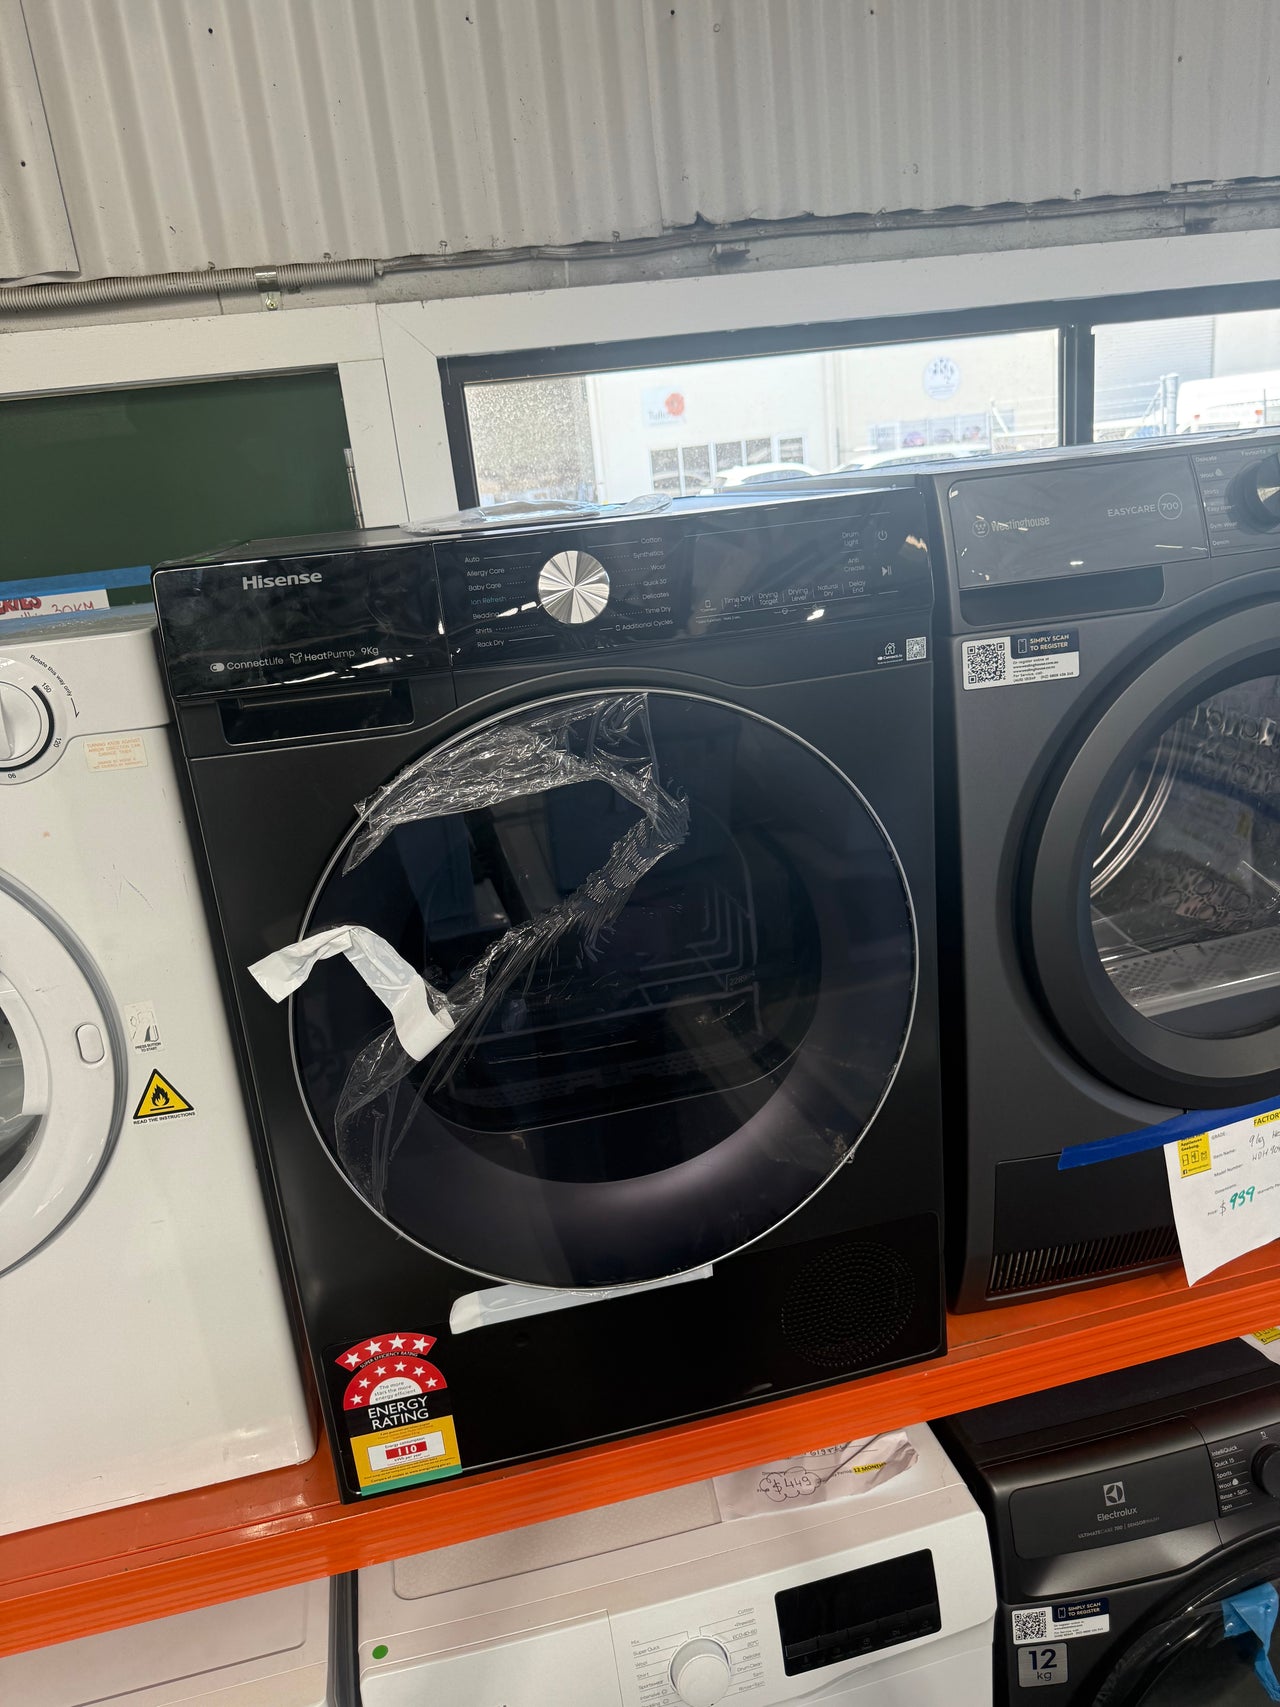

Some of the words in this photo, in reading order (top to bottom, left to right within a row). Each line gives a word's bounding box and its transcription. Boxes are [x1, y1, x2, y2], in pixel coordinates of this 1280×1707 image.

[1107, 504, 1156, 517] EASYCARE
[1161, 502, 1179, 511] 700
[633, 550, 664, 559] Synthetics
[242, 570, 323, 591] Hisense
[482, 596, 507, 604] Refresh
[643, 592, 670, 600] Delicates
[758, 592, 778, 601] Drying
[473, 612, 500, 620] Bedding
[622, 621, 652, 630] Additional
[653, 619, 674, 627] Cycles
[475, 627, 493, 635] Shirts
[1030, 636, 1051, 644] SIMPLY
[1052, 634, 1070, 642] SCAN
[1040, 642, 1068, 650] REGISTER
[227, 657, 284, 670] ConnectLife
[304, 650, 355, 662] HeatPump
[361, 647, 379, 656] 9Kg
[30, 654, 48, 669] Rotate
[48, 664, 57, 676] this
[56, 674, 65, 686] way
[64, 685, 73, 697] only
[41, 682, 52, 694] 150
[53, 737, 62, 748] 120
[159, 1112, 196, 1120] INSTRUCTIONS
[1253, 1112, 1280, 1127] FACTOR
[359, 1358, 374, 1369] SUPER
[374, 1351, 400, 1361] EFFICIENCY
[368, 1395, 427, 1419] ENERGY
[371, 1408, 429, 1430] RATING
[397, 1446, 417, 1456] 110
[1216, 1471, 1233, 1479] Sports
[772, 1475, 812, 1495] $449
[1237, 1488, 1248, 1496] Spin
[1097, 1507, 1138, 1522] Electrolux
[1076, 1607, 1100, 1615] REGISTER
[1028, 1648, 1058, 1671] 12
[1037, 1671, 1052, 1681] kg
